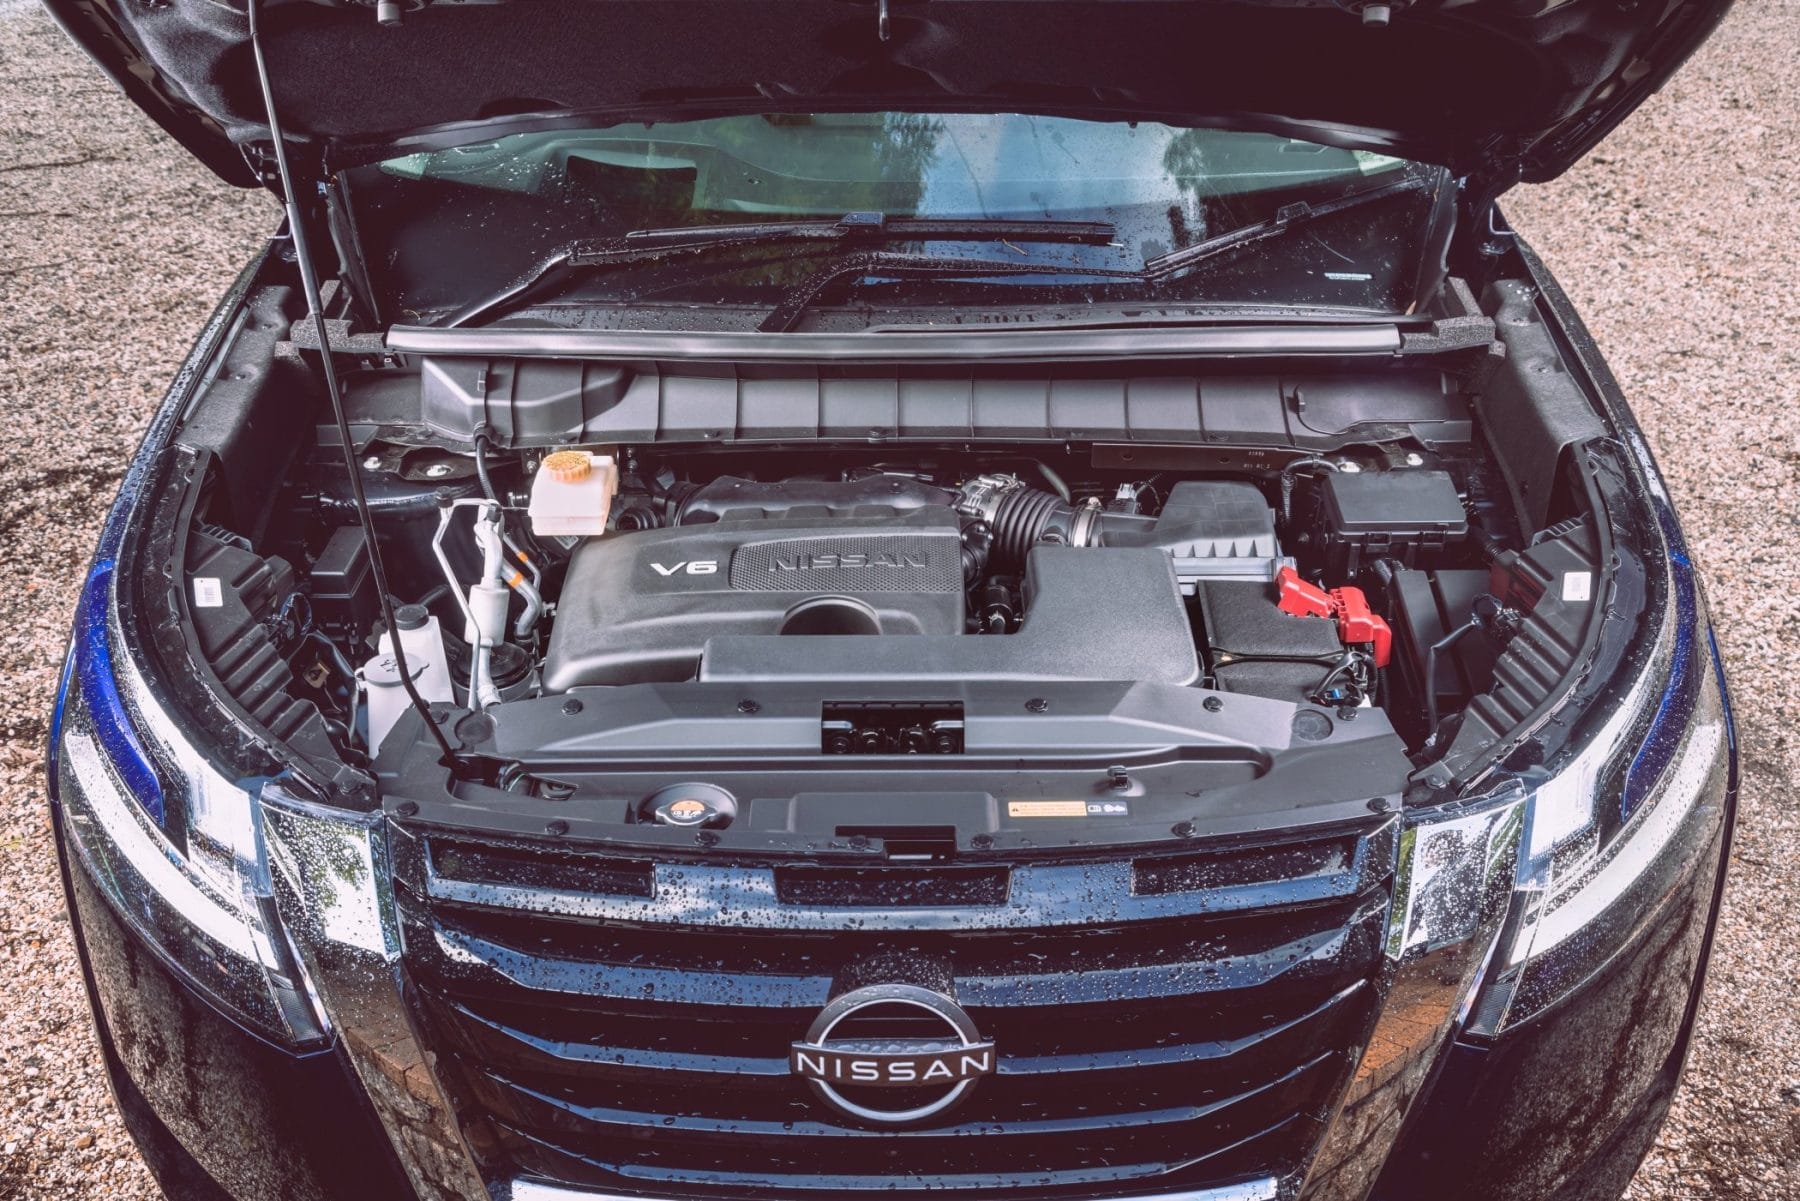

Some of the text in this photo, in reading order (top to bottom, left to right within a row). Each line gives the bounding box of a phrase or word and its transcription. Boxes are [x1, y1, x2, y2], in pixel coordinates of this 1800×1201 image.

[651, 560, 718, 577] V6
[768, 552, 925, 572] NISSAN
[797, 1051, 989, 1081] NISSAN
